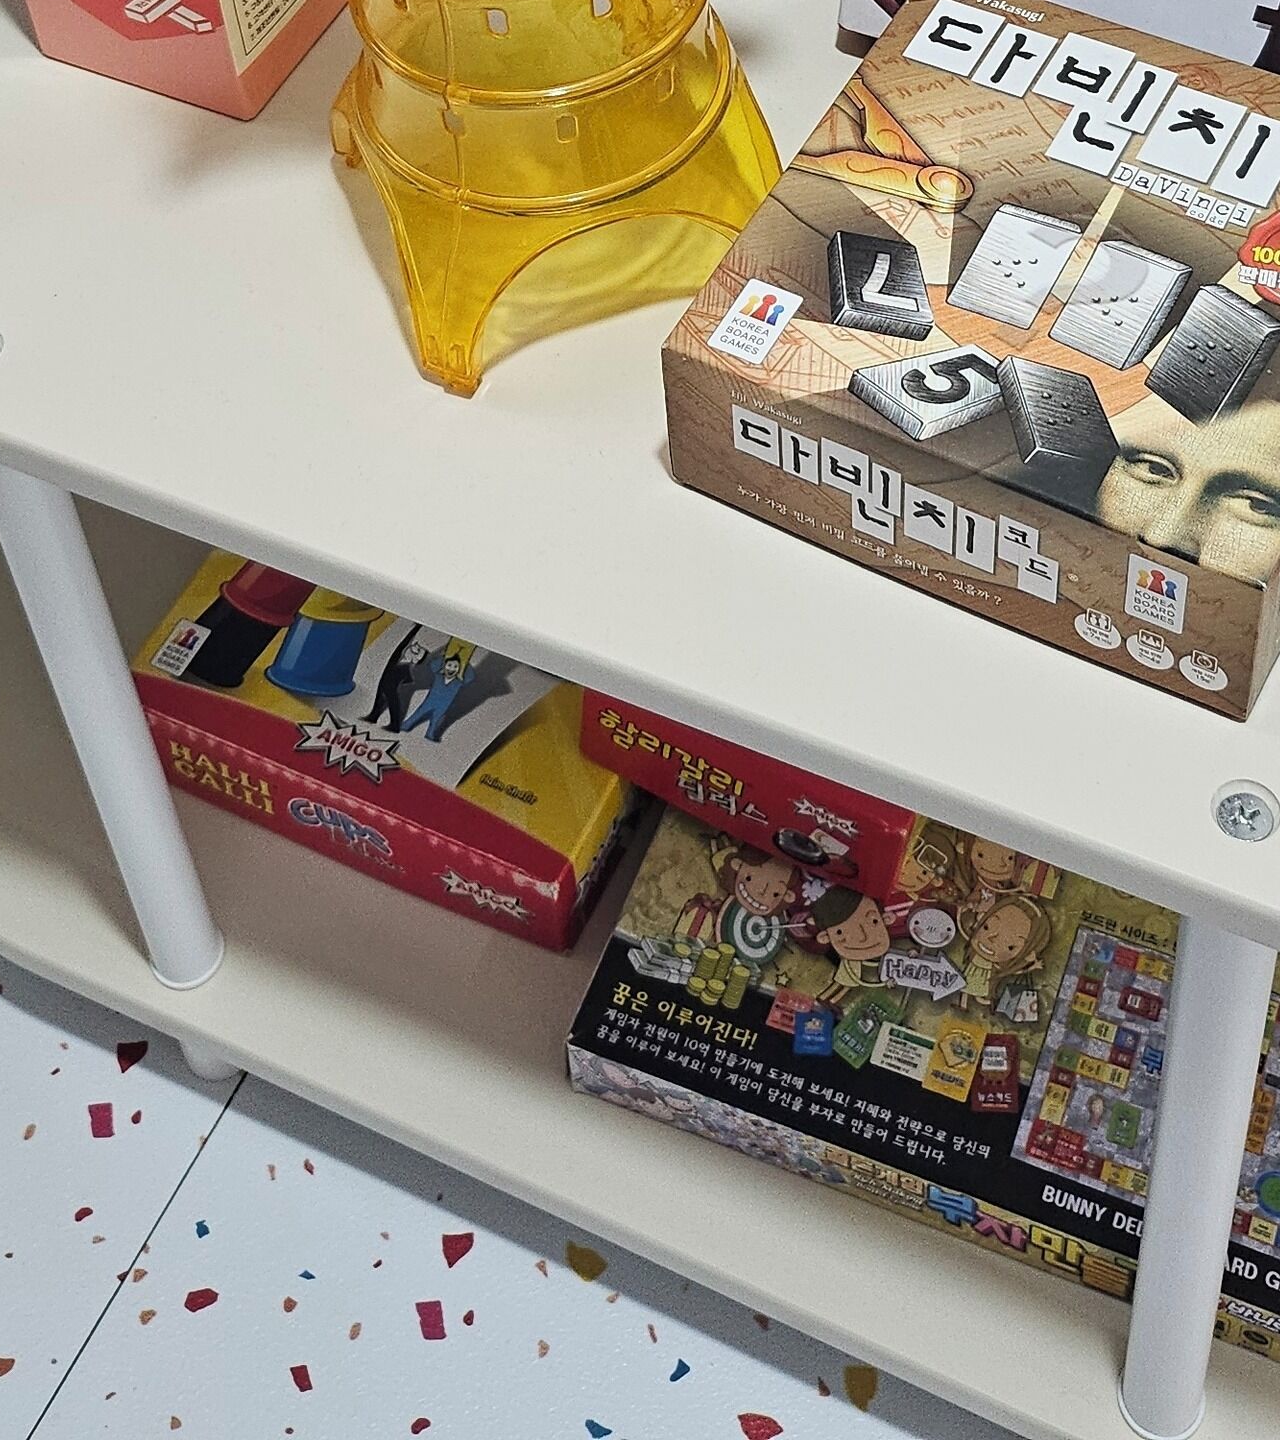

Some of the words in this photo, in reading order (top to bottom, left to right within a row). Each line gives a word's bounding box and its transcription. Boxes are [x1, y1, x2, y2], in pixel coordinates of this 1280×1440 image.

[928, 15, 1269, 180] 다빈치
[1114, 165, 1248, 223] DaVinci
[719, 334, 760, 356] GAMES
[725, 325, 765, 346] BOARD
[731, 316, 770, 337] KOREA
[753, 399, 803, 425] Wakasugi
[739, 418, 976, 554] 다빈치
[1004, 525, 1053, 581] 코드
[737, 483, 761, 502] 누가
[764, 497, 787, 515] 가장
[792, 510, 816, 528] 먼저
[934, 571, 948, 582] 수
[952, 578, 990, 601] 있을까
[1133, 605, 1175, 627] GAMES
[1134, 588, 1177, 611] KOREA
[1134, 596, 1176, 619] BOARD
[170, 739, 271, 796] HALLI
[317, 728, 385, 763] AMIGO
[599, 709, 745, 796] 할리갈리
[174, 760, 275, 816] GALLI
[886, 958, 959, 989] Happy
[613, 981, 649, 1014] 꿈은
[657, 1001, 759, 1051] 이루어진다!
[596, 1022, 621, 1044] 꿈을
[625, 1034, 662, 1057] 이루어
[666, 1048, 706, 1074] 보세요!
[709, 1065, 721, 1080] 이
[725, 1071, 764, 1095] 게임이
[767, 1086, 804, 1113] 당신을
[808, 1101, 845, 1126] 부자로
[850, 1117, 889, 1143] 만들어
[892, 1134, 947, 1166] 드립니다.
[604, 1007, 640, 1030] 게임자
[645, 1021, 680, 1046] 전원이
[684, 1035, 711, 1056] 10억
[714, 1048, 764, 1076] 만들기에
[767, 1067, 805, 1091] 도전해
[808, 1082, 850, 1108] 보세요!
[853, 1098, 892, 1123] 지혜와
[895, 1114, 949, 1144] 전략으로
[952, 1135, 991, 1159] 당신의
[1042, 1183, 1107, 1223] BUNNY
[1112, 1210, 1144, 1239] DEL
